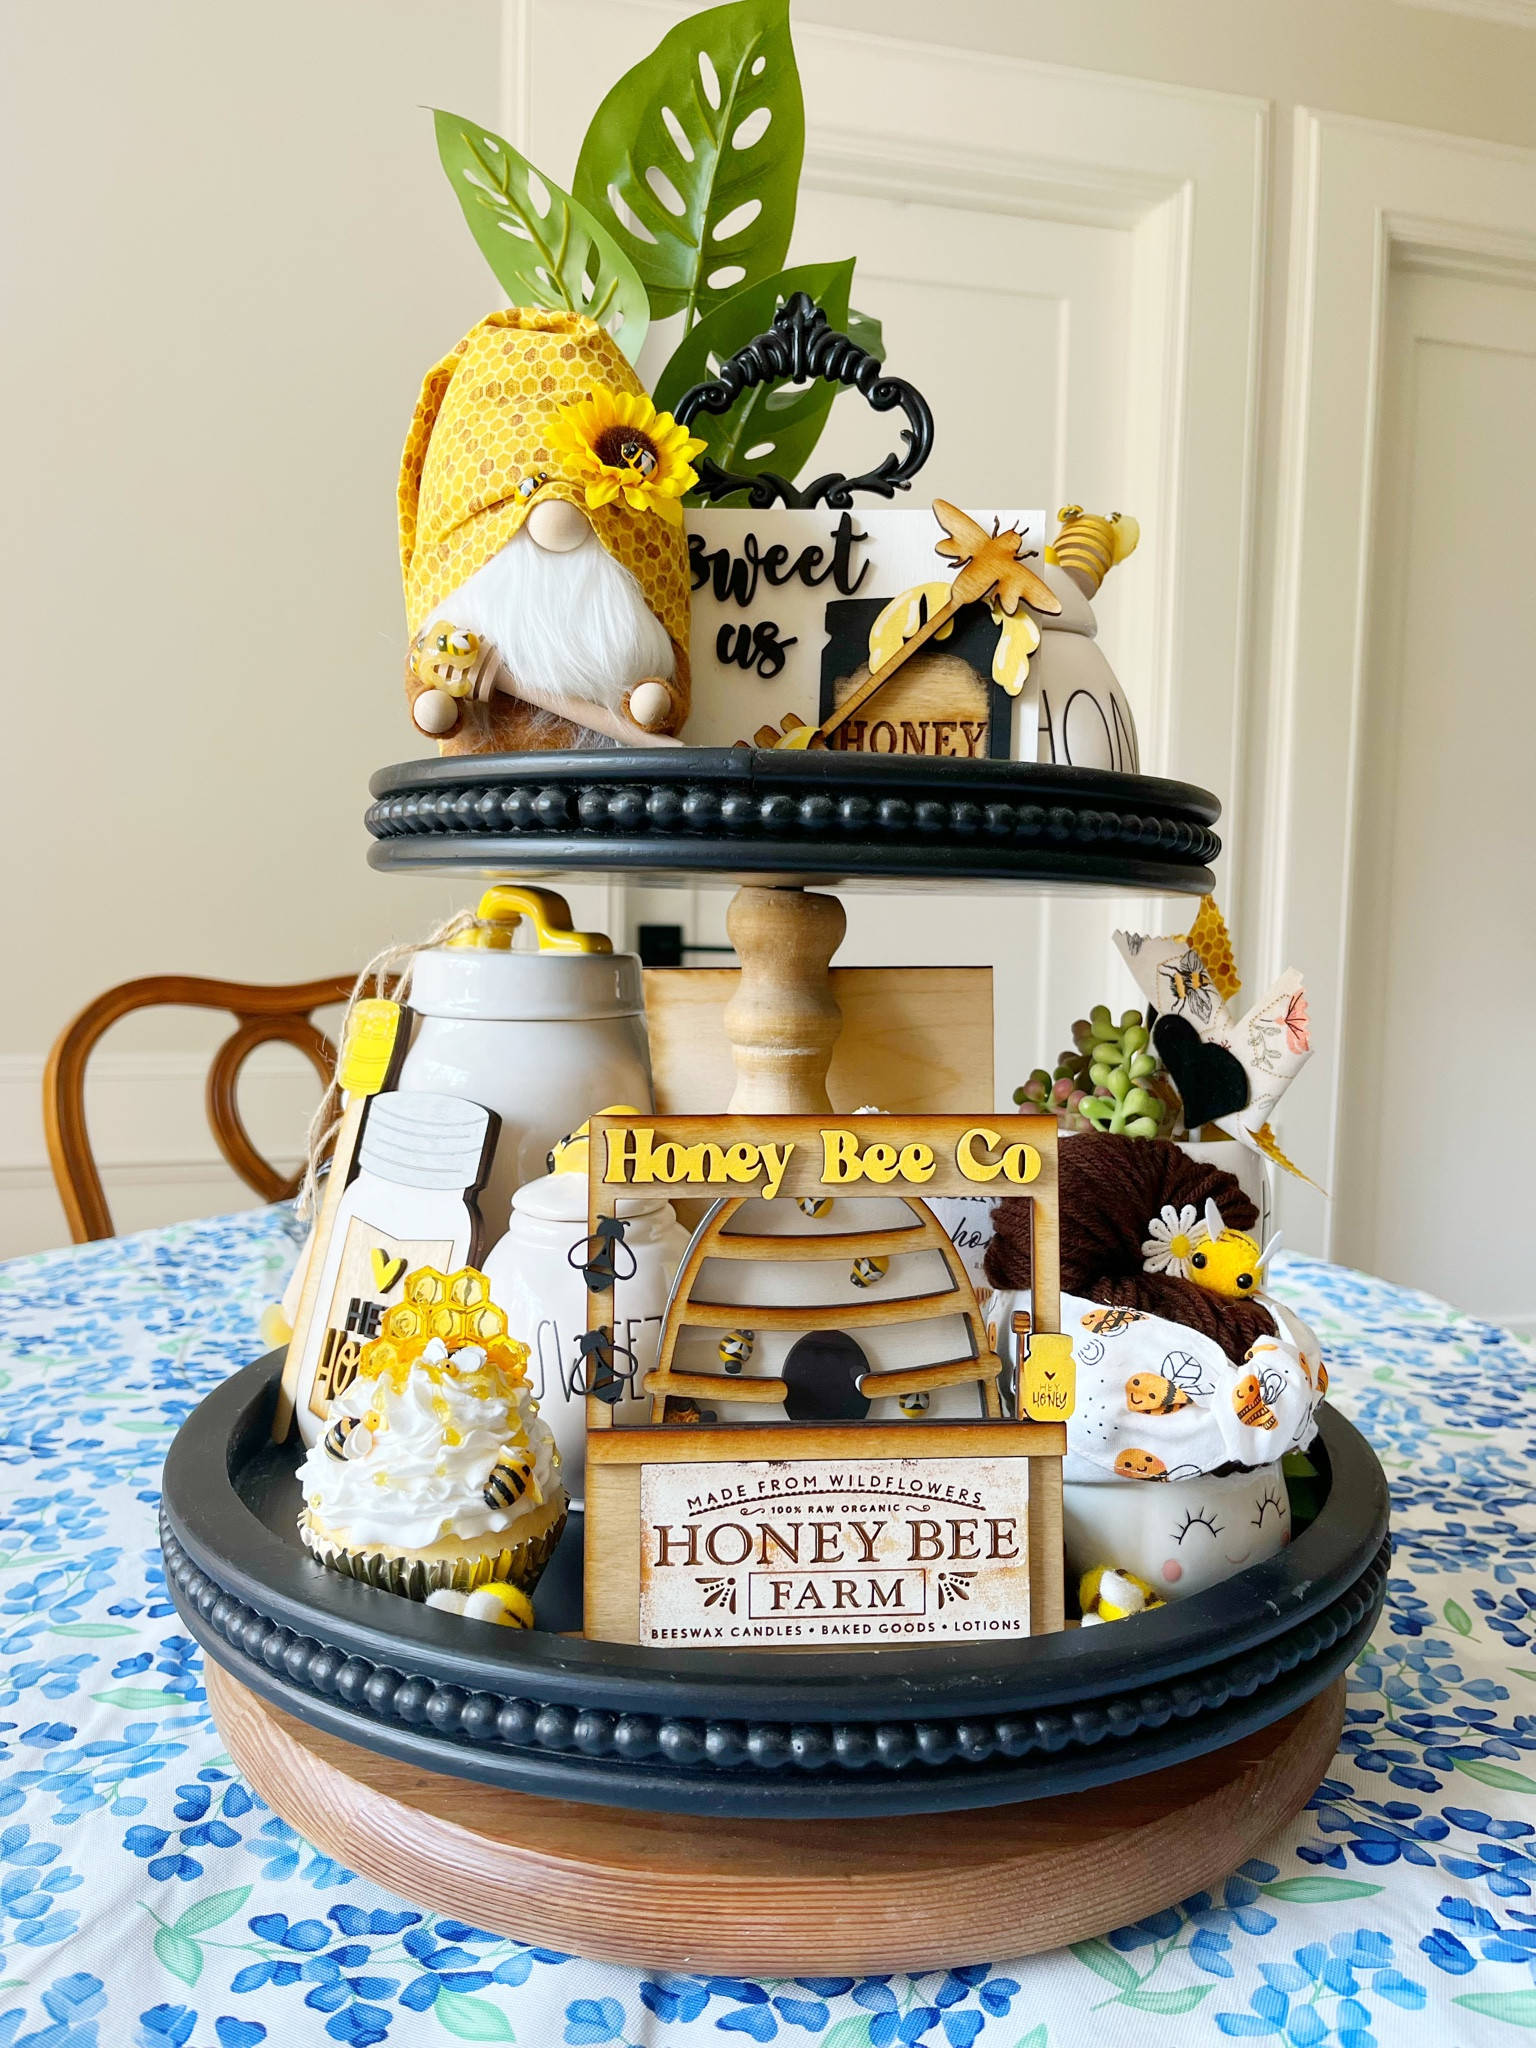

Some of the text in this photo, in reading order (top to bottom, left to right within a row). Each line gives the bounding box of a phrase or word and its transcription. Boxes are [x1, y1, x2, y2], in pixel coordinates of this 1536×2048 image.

[716, 621, 798, 679] as
[840, 720, 988, 758] HONEY
[602, 1127, 1042, 1201] Honey Bee Co
[951, 1216, 992, 1250] ho
[345, 1297, 390, 1340] HE
[687, 1474, 982, 1510] MADE FROM WILDFLOWERS
[771, 1503, 901, 1514] 100% RAW ORGANIC
[653, 1518, 1020, 1567] HONEY BEE
[769, 1578, 906, 1611] FARM
[651, 1619, 1021, 1639] BEESWAX CANDLES BAKED GOODS LOTIONS
